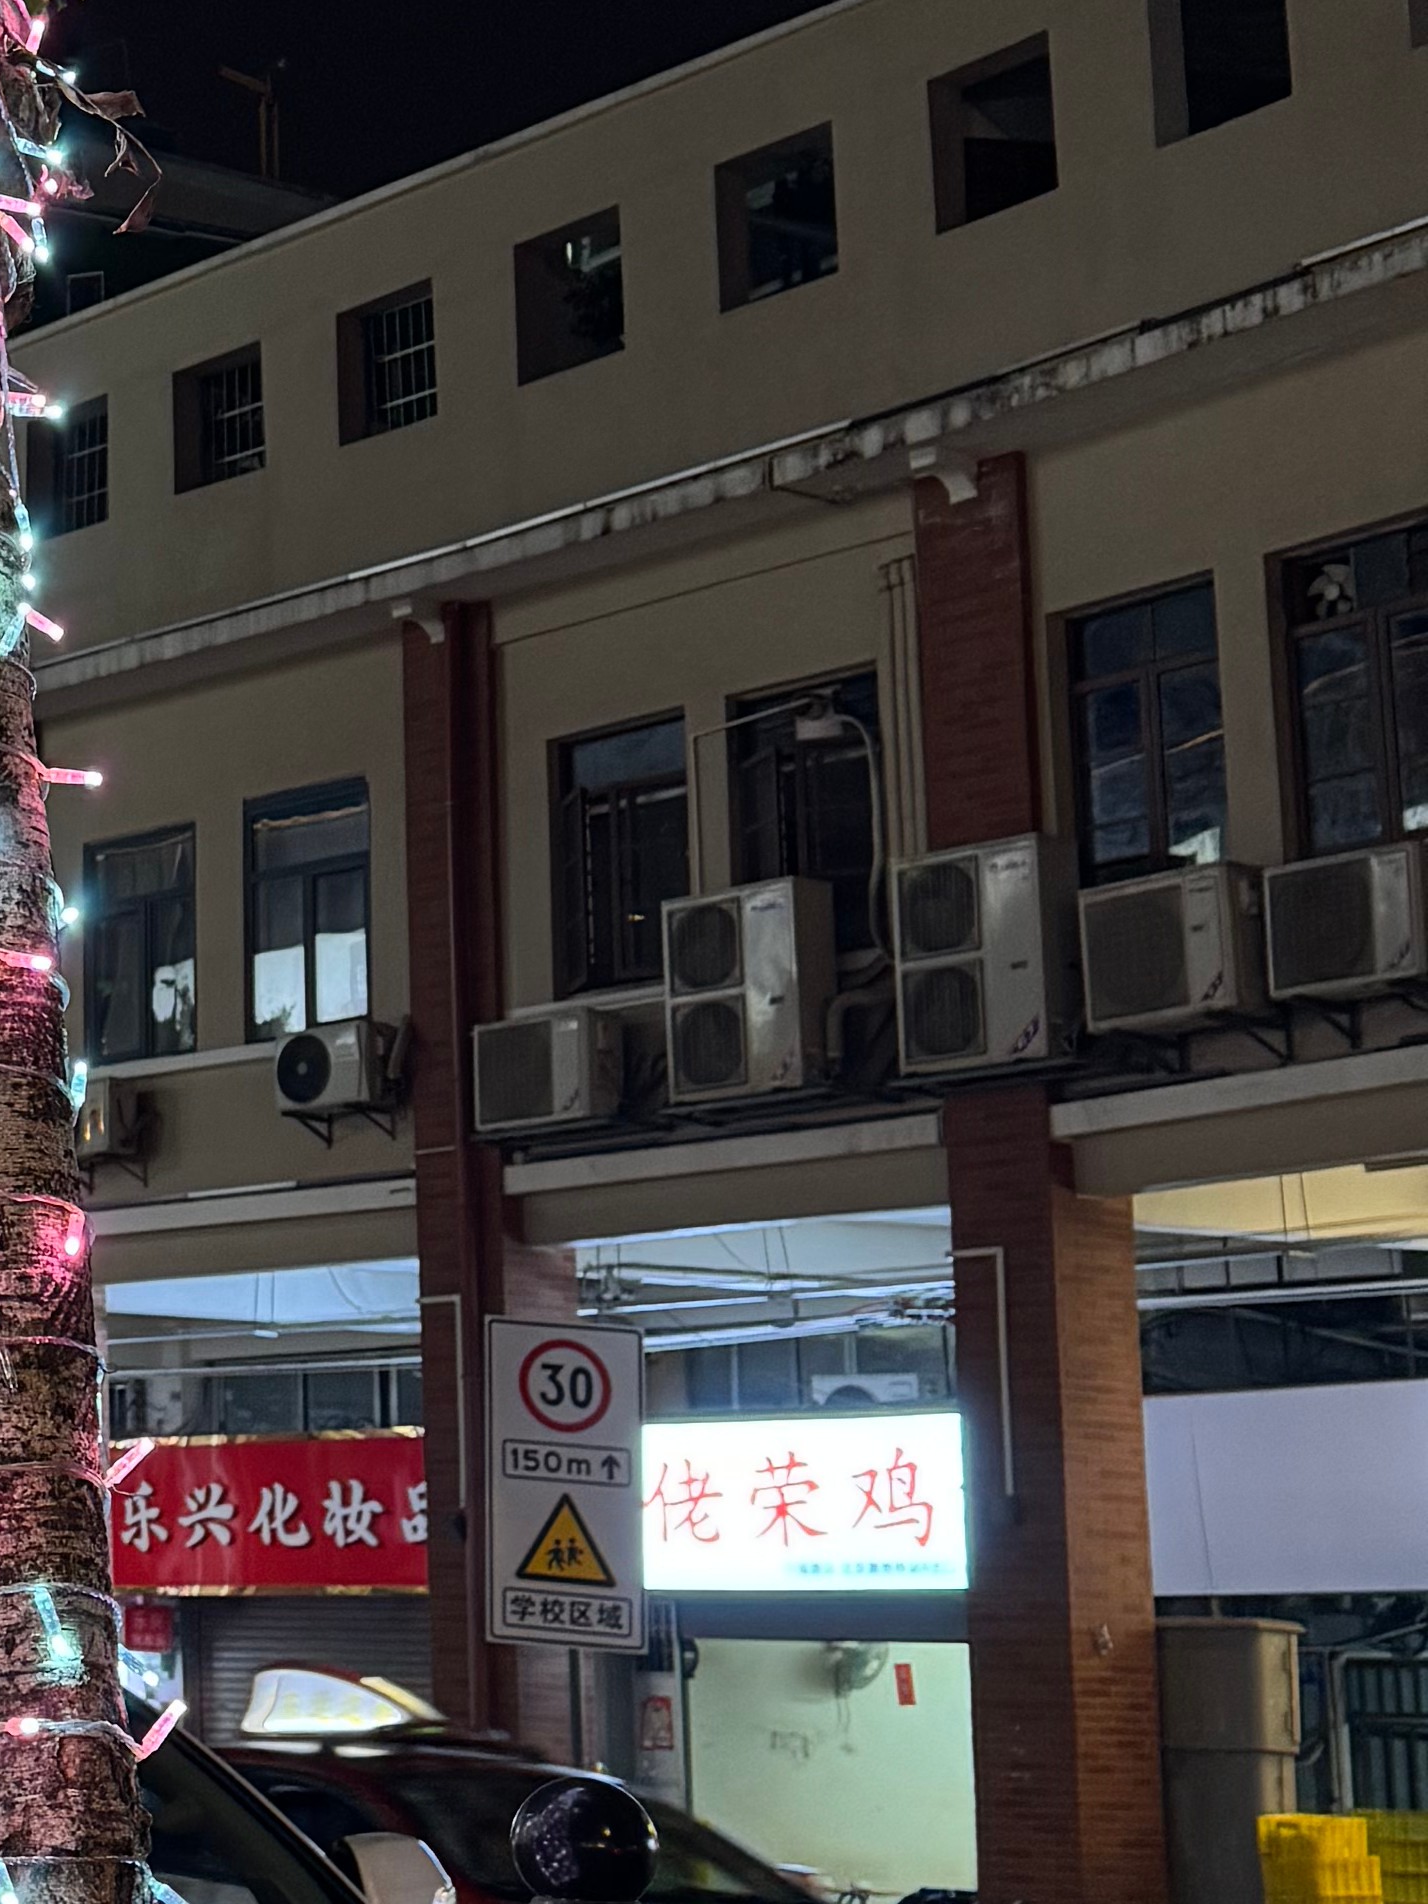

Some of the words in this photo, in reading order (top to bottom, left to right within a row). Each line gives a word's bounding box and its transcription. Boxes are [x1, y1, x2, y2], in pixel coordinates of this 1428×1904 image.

[539, 1363, 593, 1409] 30
[510, 1448, 591, 1476] 150m
[641, 1447, 934, 1547] 佬荣鸡
[509, 1596, 624, 1631] 学校区域
